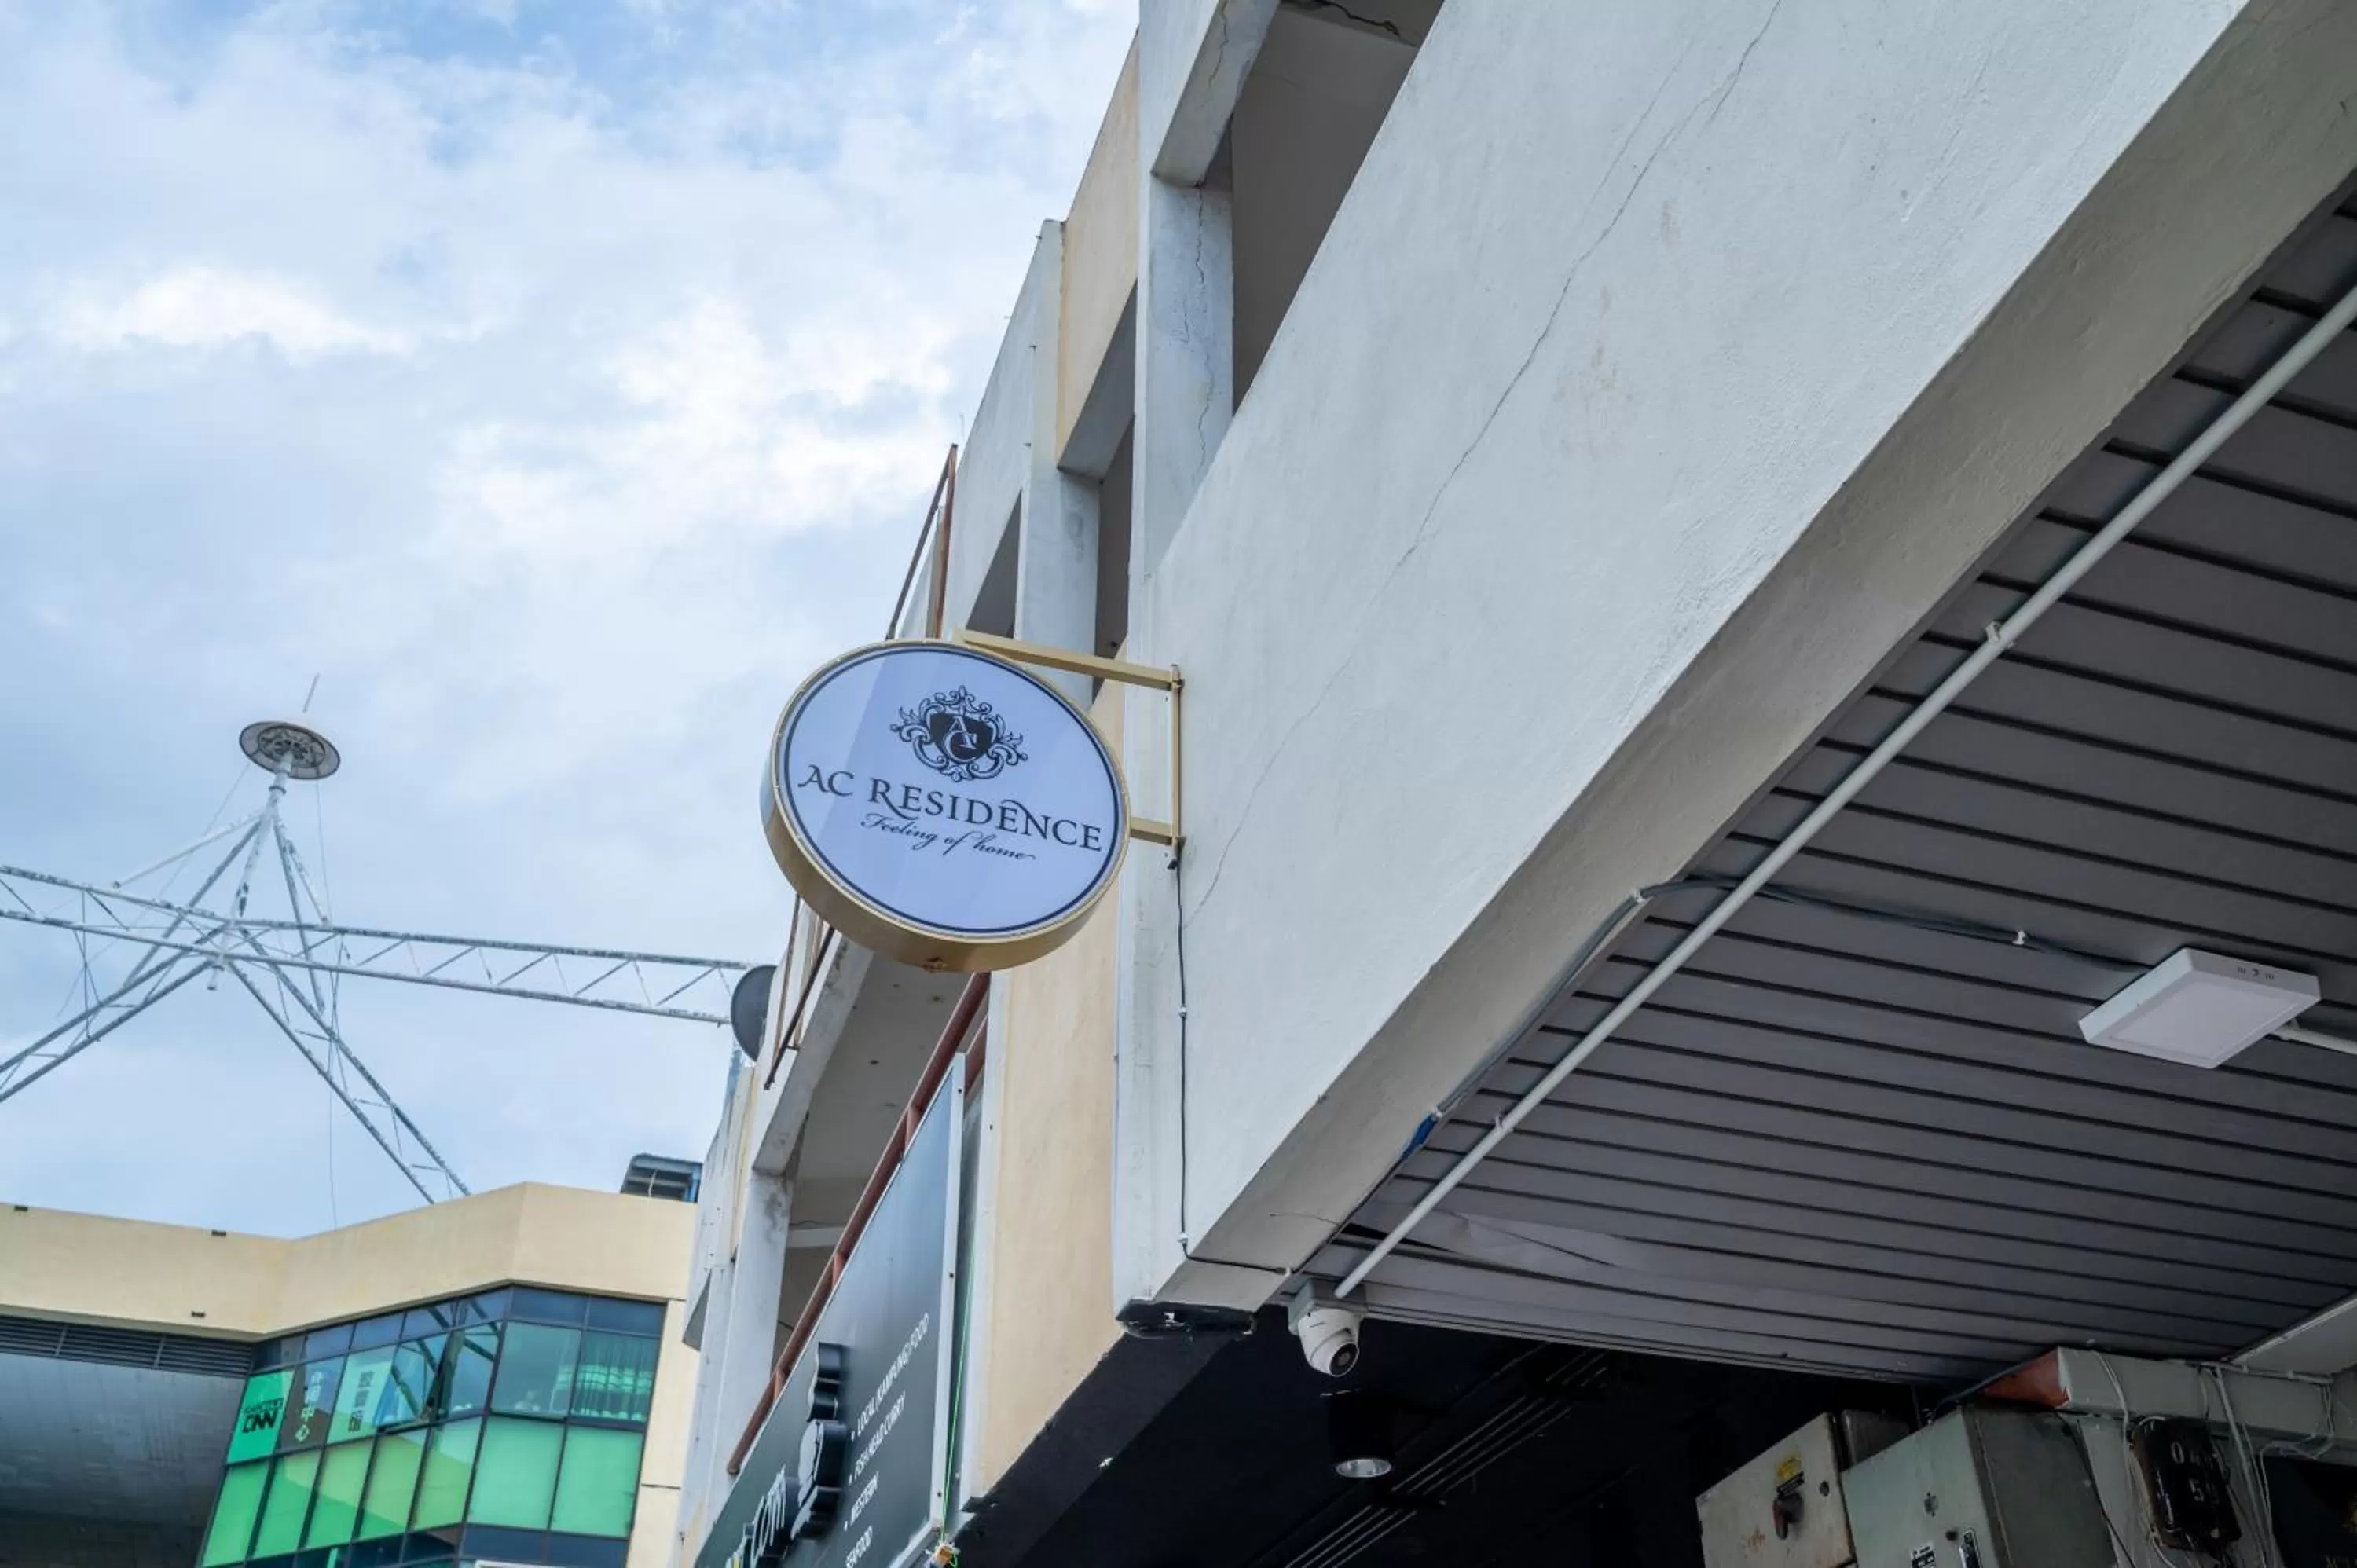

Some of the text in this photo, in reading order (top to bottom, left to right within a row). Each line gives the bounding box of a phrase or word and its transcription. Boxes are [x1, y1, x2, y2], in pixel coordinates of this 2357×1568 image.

[797, 765, 1102, 852] AC RESIDENCE
[860, 813, 1036, 860] Feeling of home
